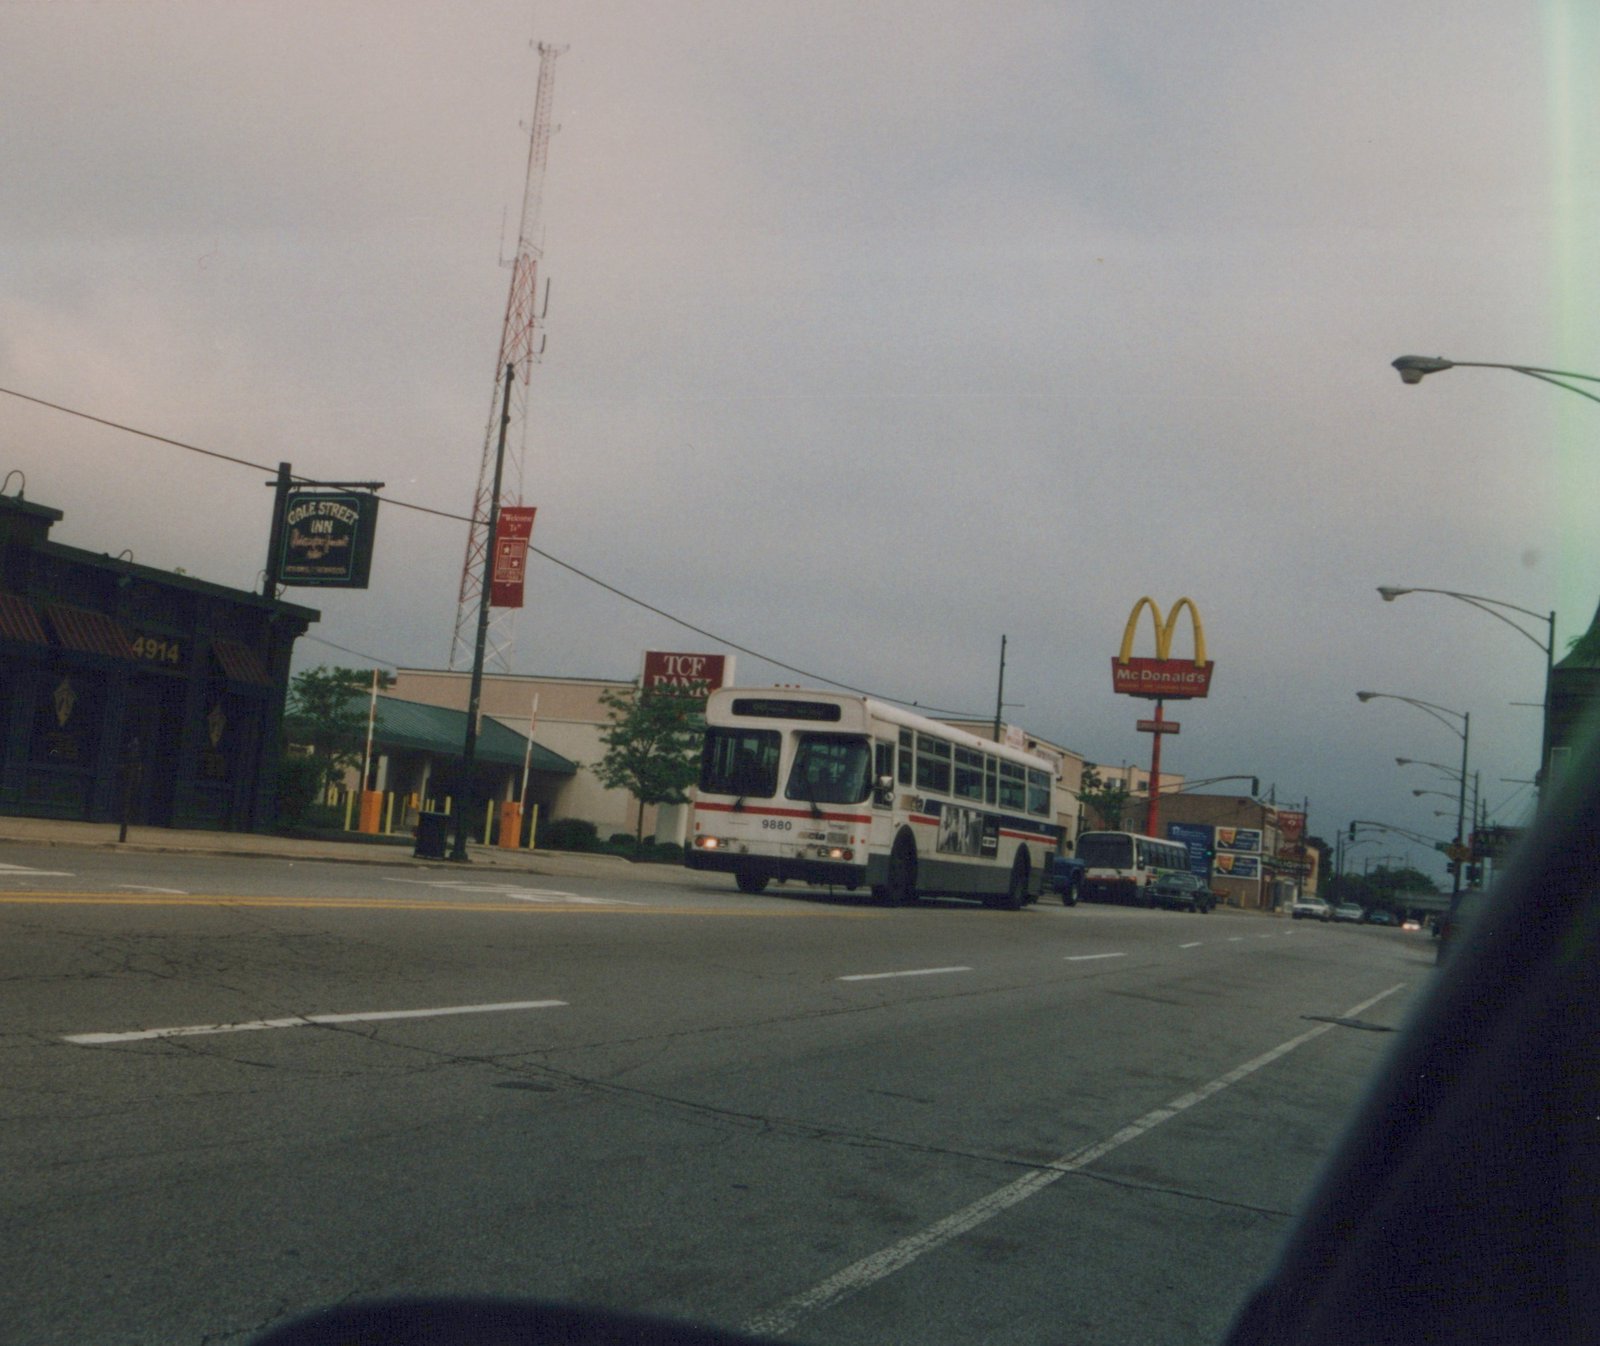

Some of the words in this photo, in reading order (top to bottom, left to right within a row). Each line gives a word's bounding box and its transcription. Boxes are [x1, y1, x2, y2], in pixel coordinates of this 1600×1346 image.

[318, 502, 359, 525] STREET
[311, 520, 333, 533] INN
[131, 636, 179, 663] 4914
[664, 655, 706, 676] TCF
[1116, 669, 1206, 683] McDonald's
[761, 819, 792, 831] 9880
